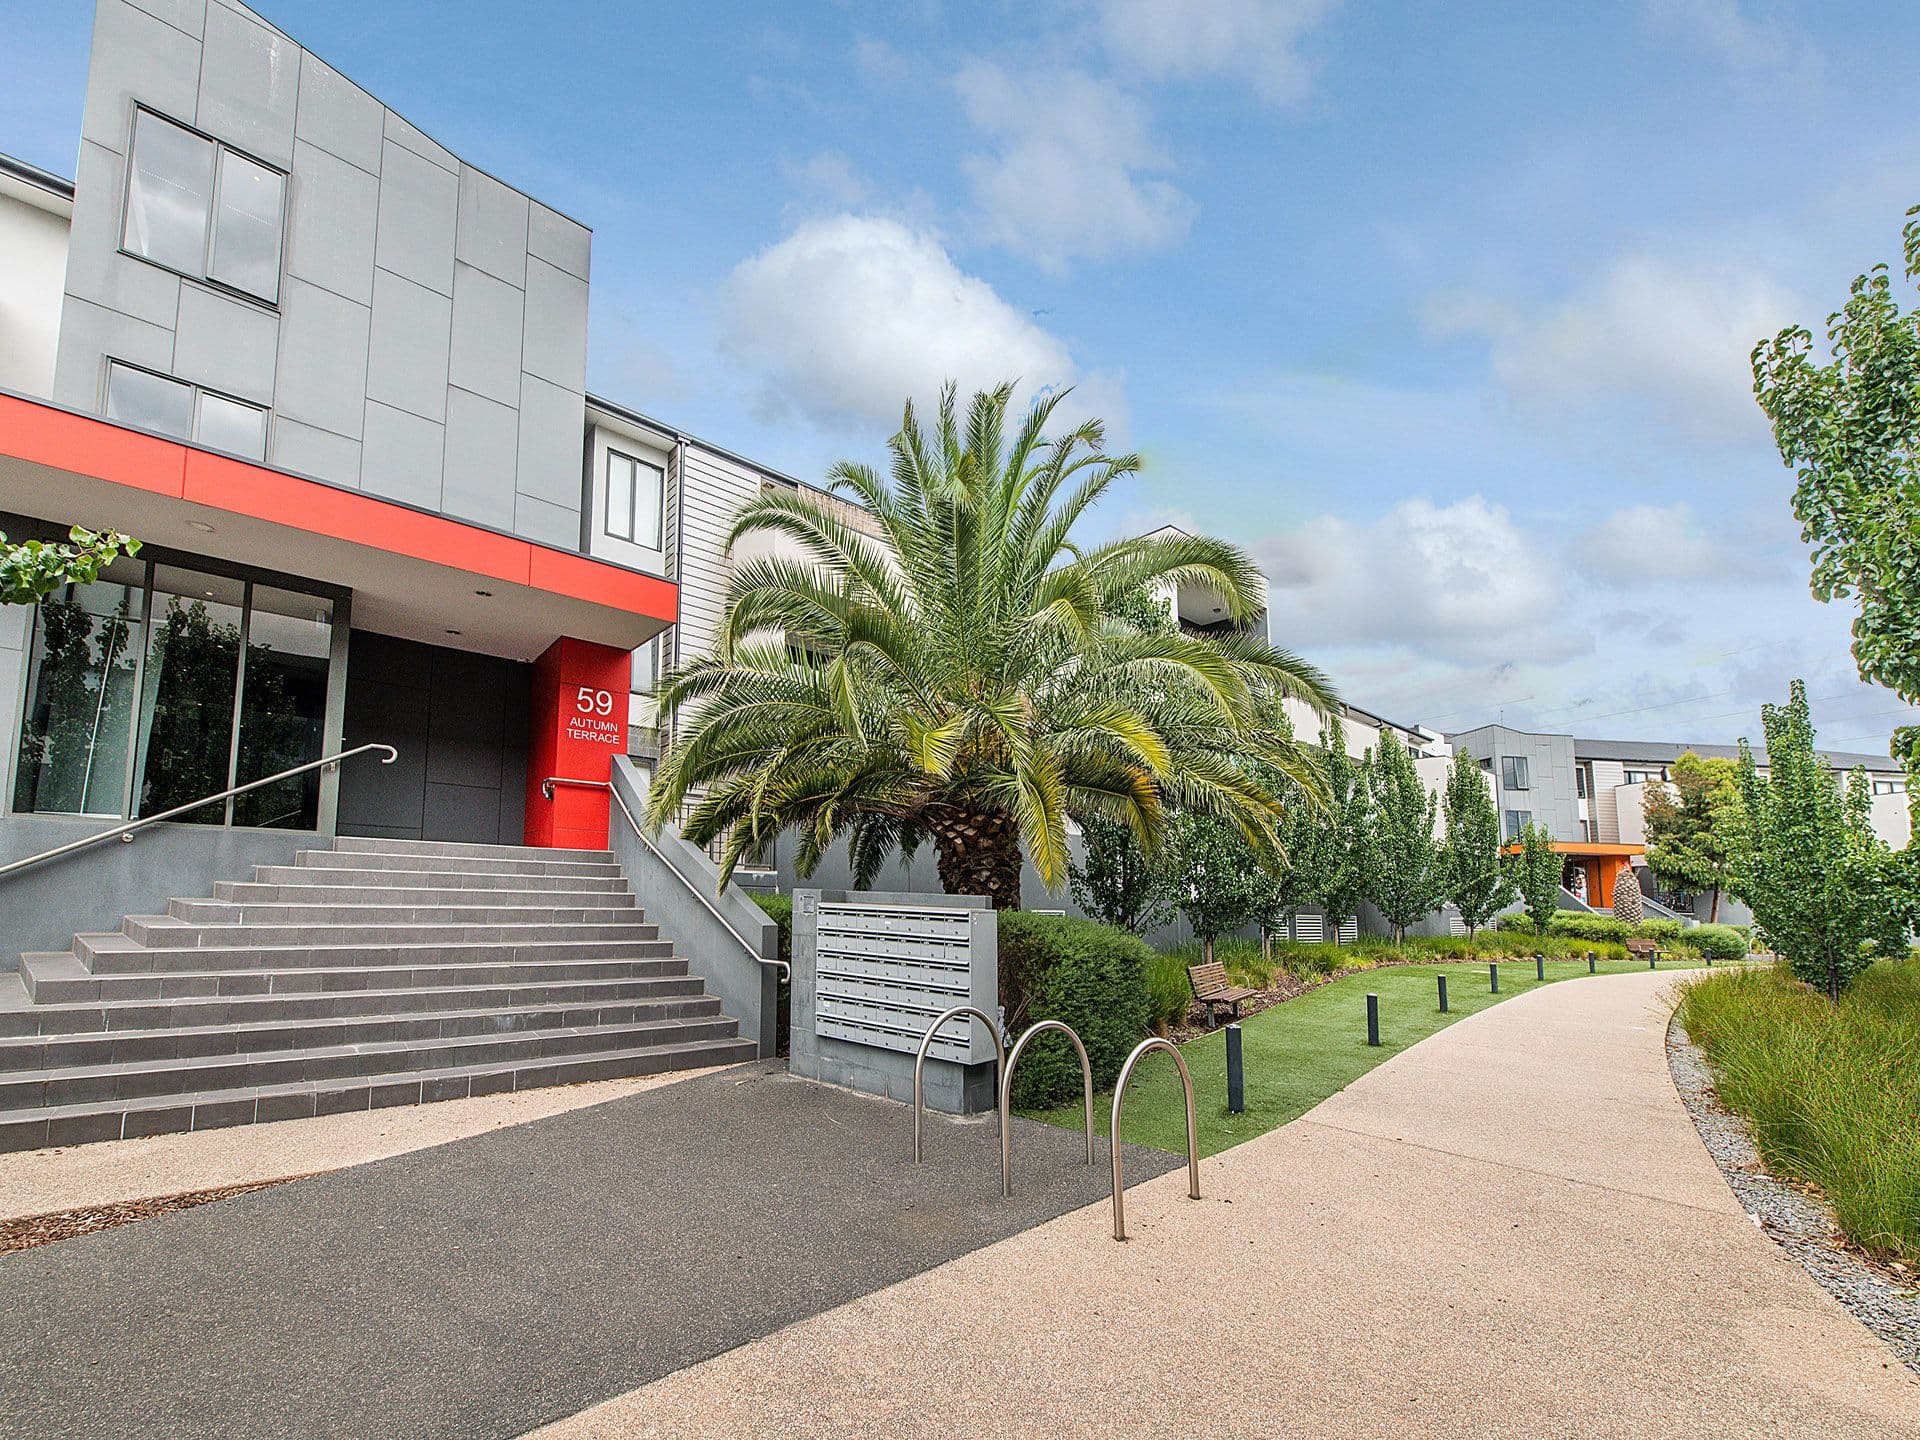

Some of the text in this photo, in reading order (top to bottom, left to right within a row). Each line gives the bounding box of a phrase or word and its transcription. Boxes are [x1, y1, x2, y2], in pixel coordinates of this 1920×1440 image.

[577, 687, 613, 716] 59
[570, 717, 618, 732] AUTUMN
[566, 728, 620, 745] TERRACE
